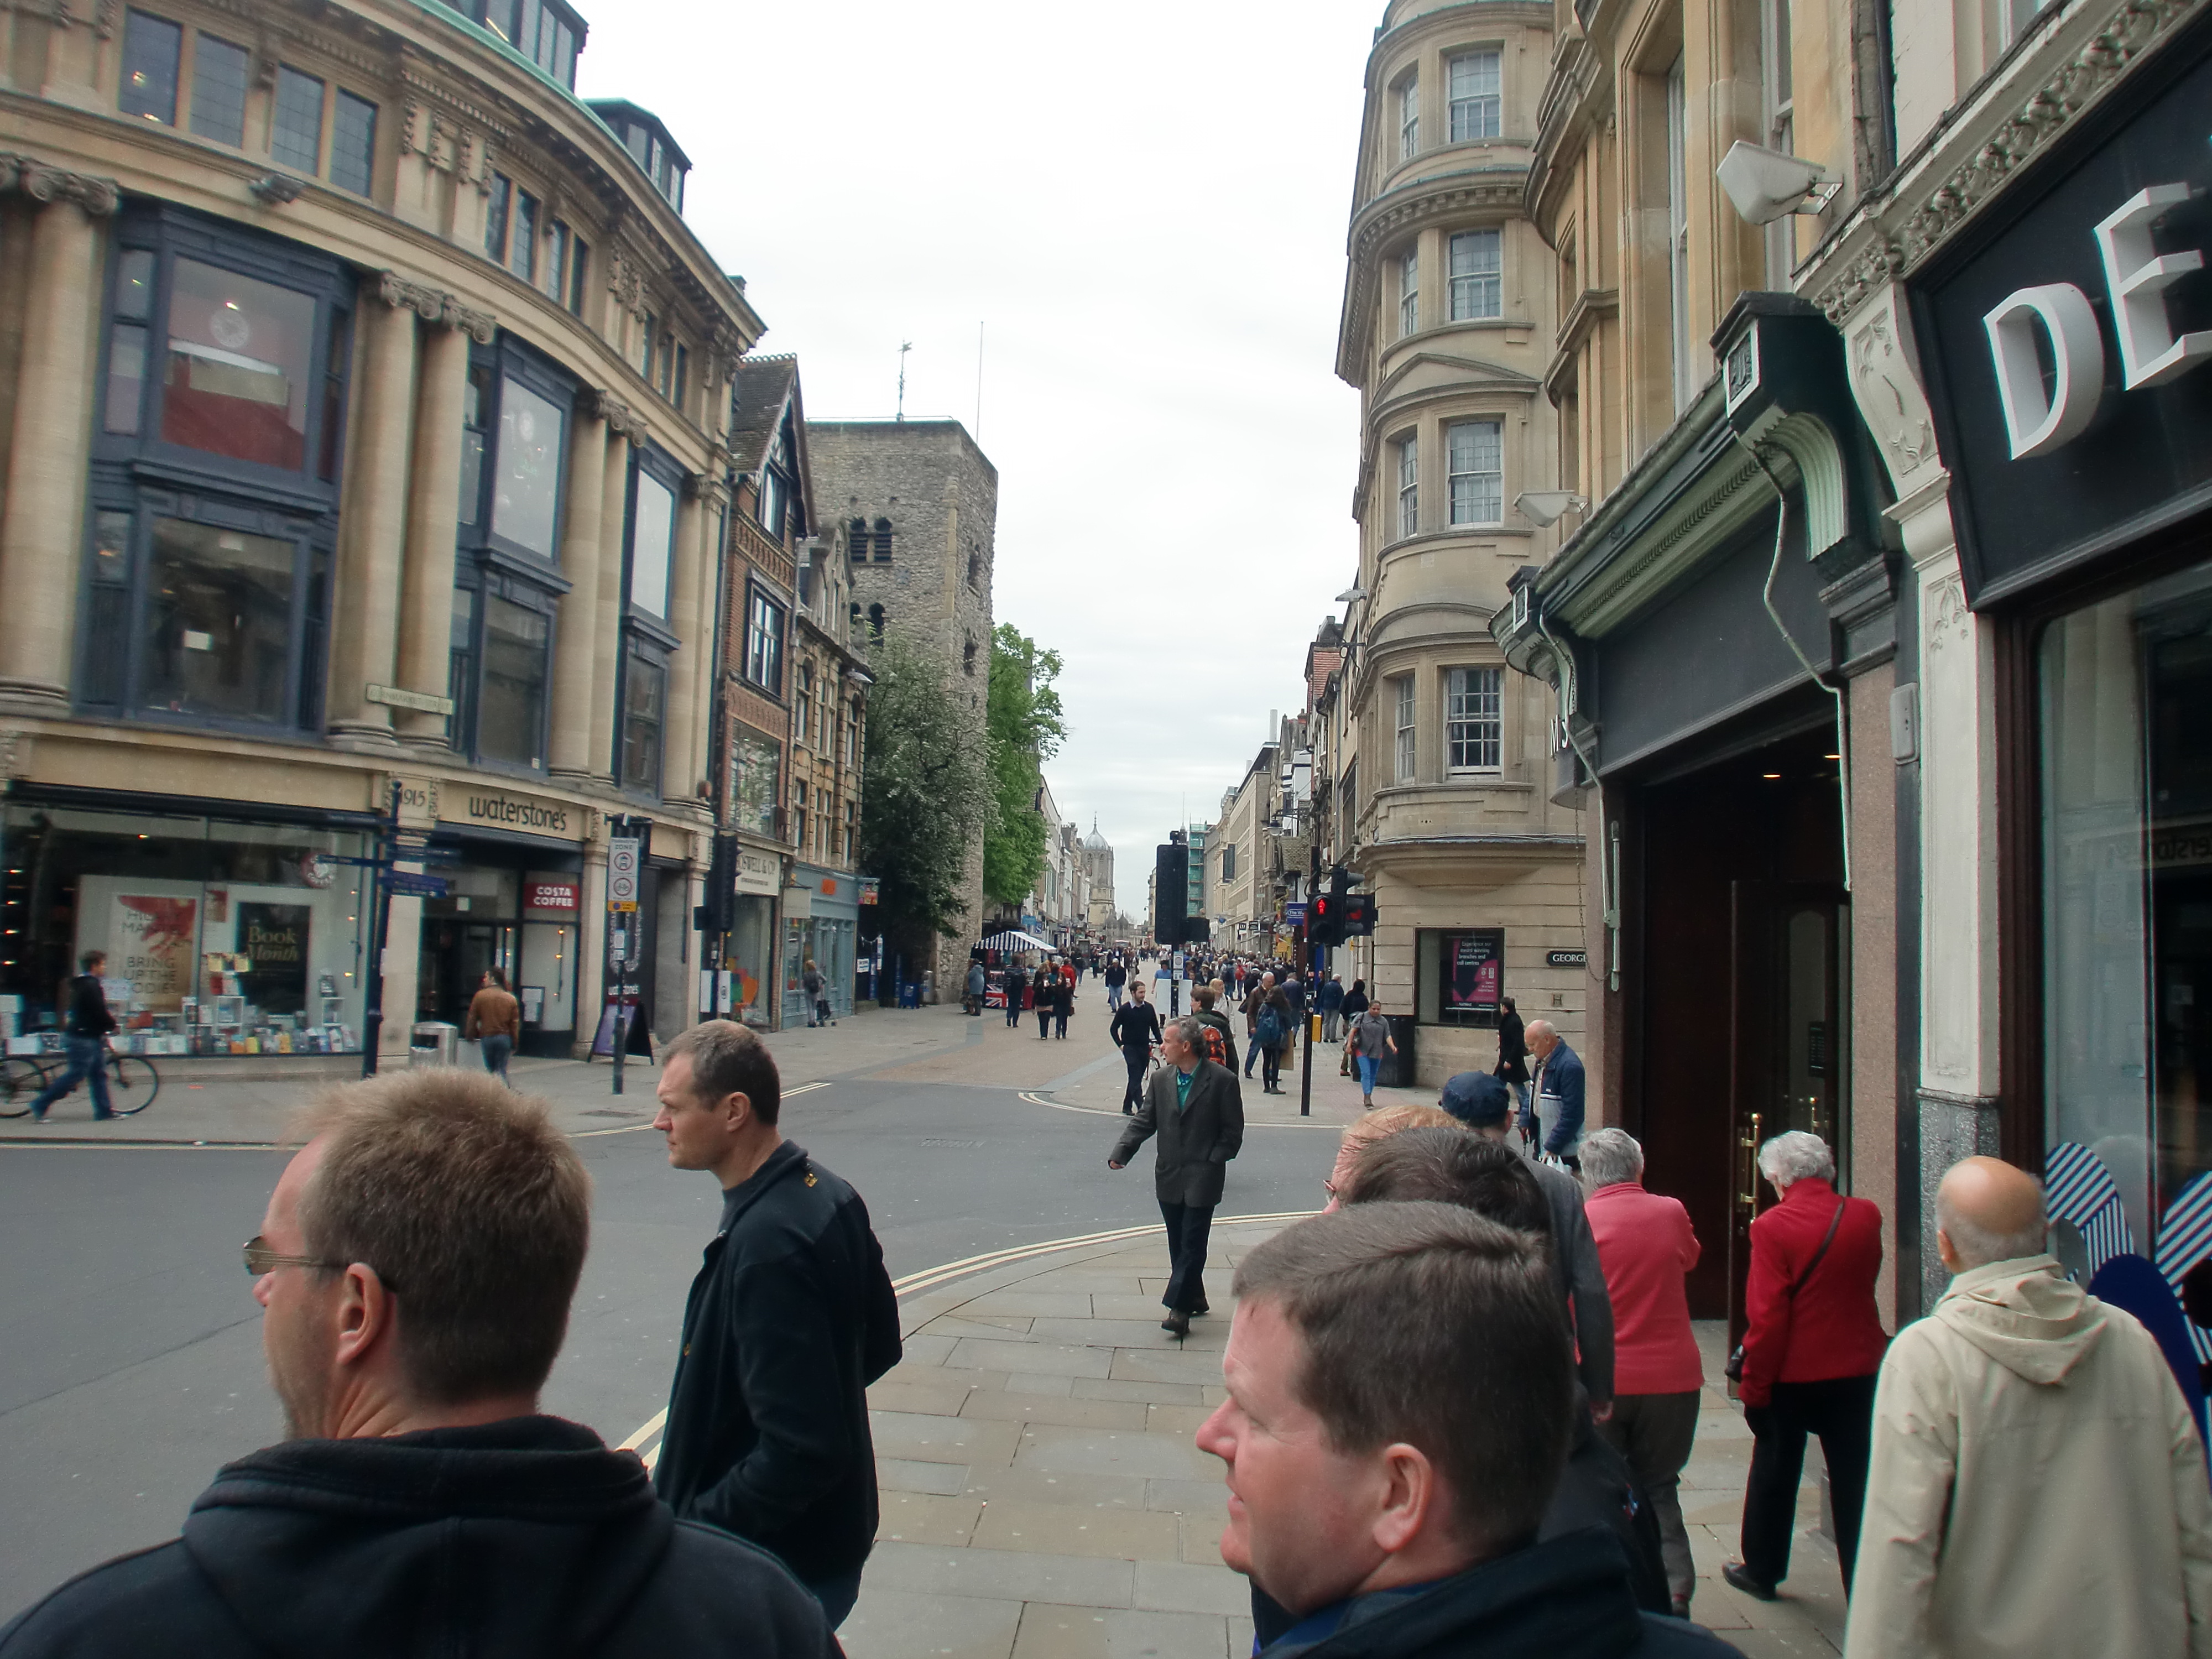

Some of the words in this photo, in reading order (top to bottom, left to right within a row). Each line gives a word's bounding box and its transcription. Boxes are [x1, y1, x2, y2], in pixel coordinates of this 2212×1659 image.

[400, 789, 425, 807] 1915
[536, 886, 572, 896] COSTA
[534, 897, 573, 906] COFFEE
[249, 926, 296, 943] Book
[127, 957, 175, 969] BRING
[123, 969, 144, 980] UP
[145, 969, 178, 982] THE
[131, 982, 177, 994] ODIES
